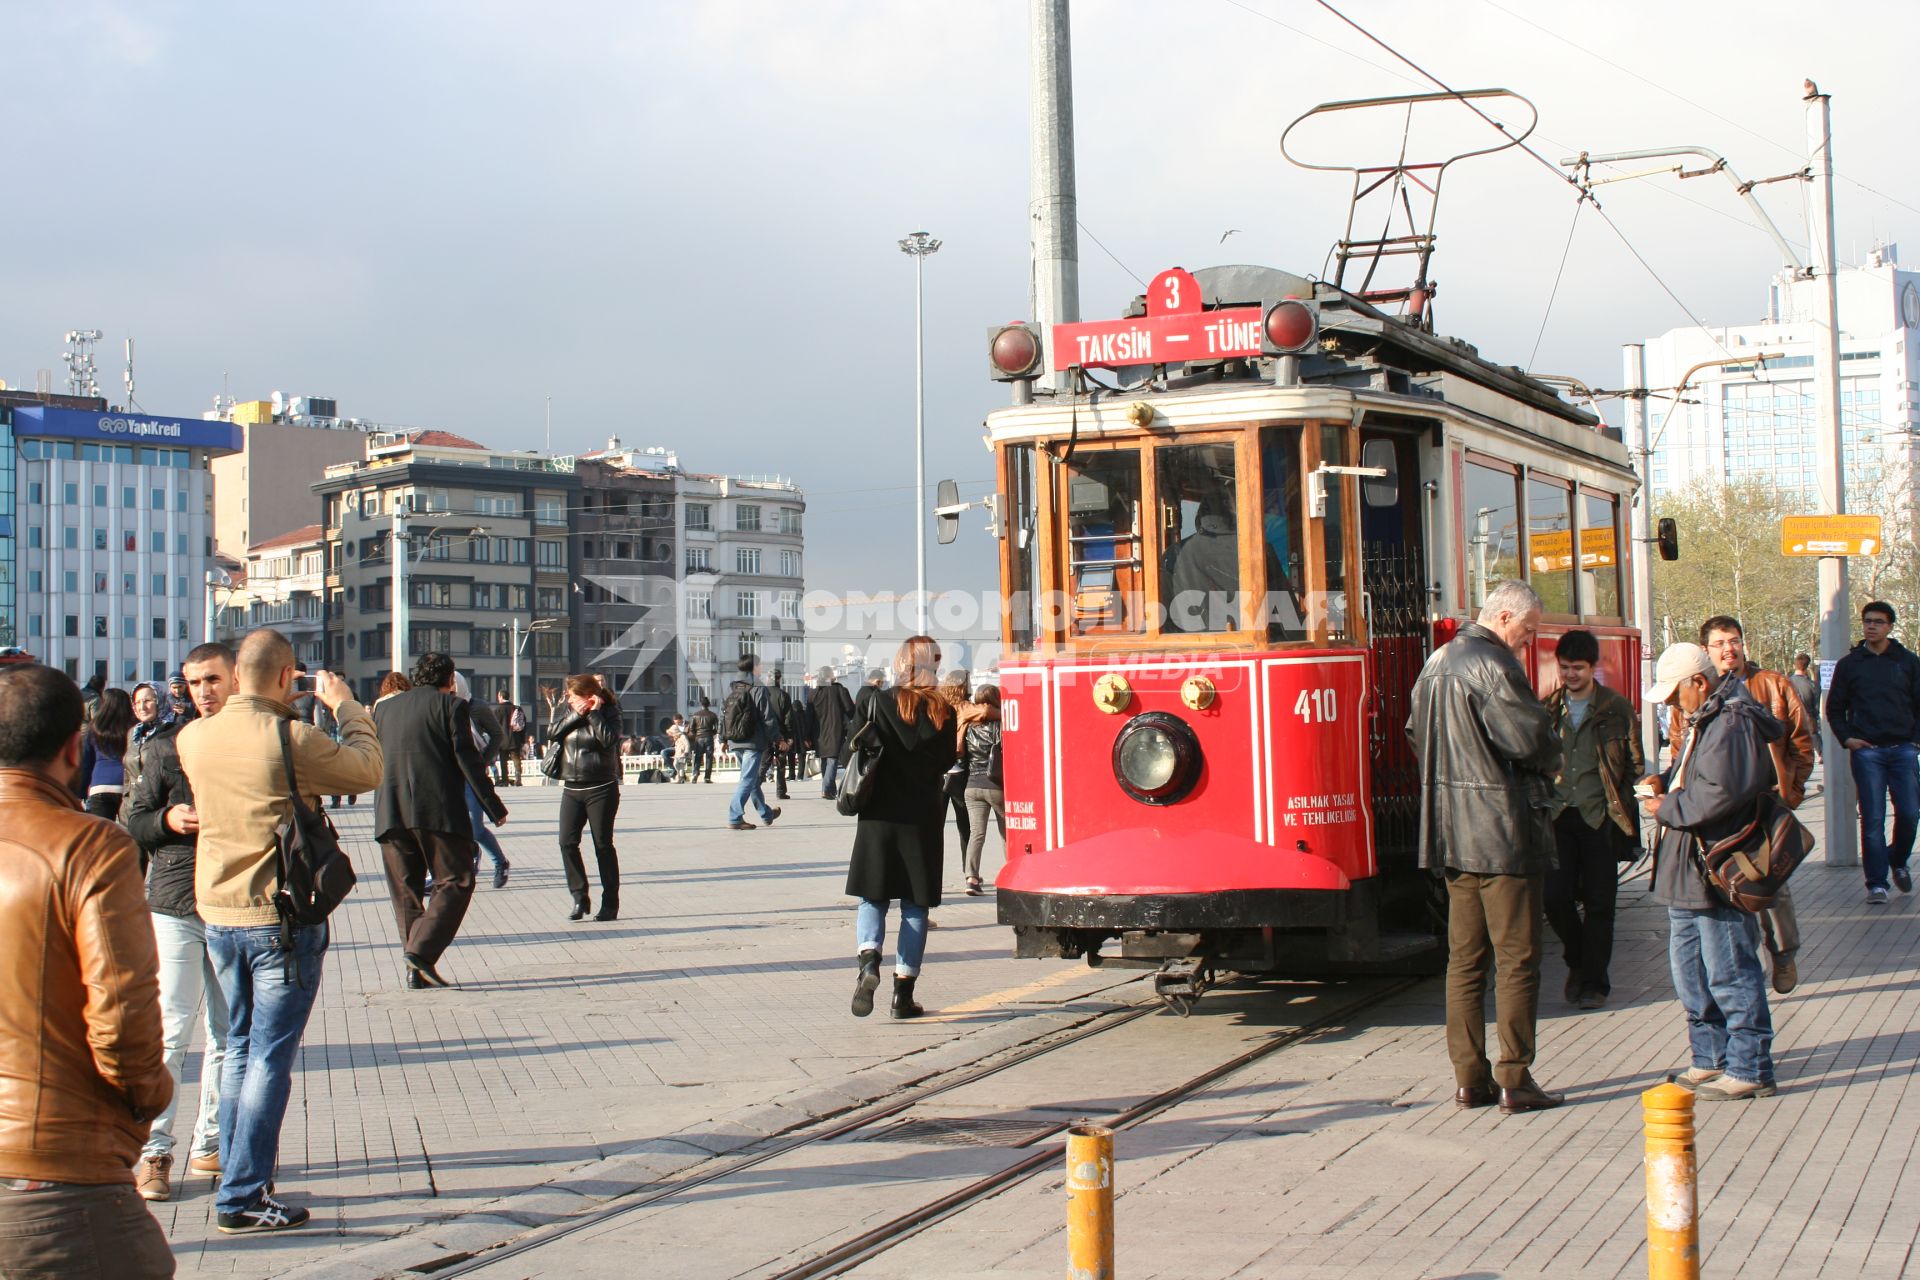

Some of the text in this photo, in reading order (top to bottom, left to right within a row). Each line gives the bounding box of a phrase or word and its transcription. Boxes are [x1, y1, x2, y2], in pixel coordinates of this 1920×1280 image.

[1165, 276, 1180, 309] 3
[1076, 326, 1152, 363] TAKSİM
[1204, 318, 1262, 353] TÜNE
[1001, 698, 1019, 732] 10
[1294, 688, 1337, 724] 410
[1013, 801, 1034, 814] YASAK
[1287, 793, 1355, 810] ASILMAK YASAK
[1283, 813, 1298, 827] VE
